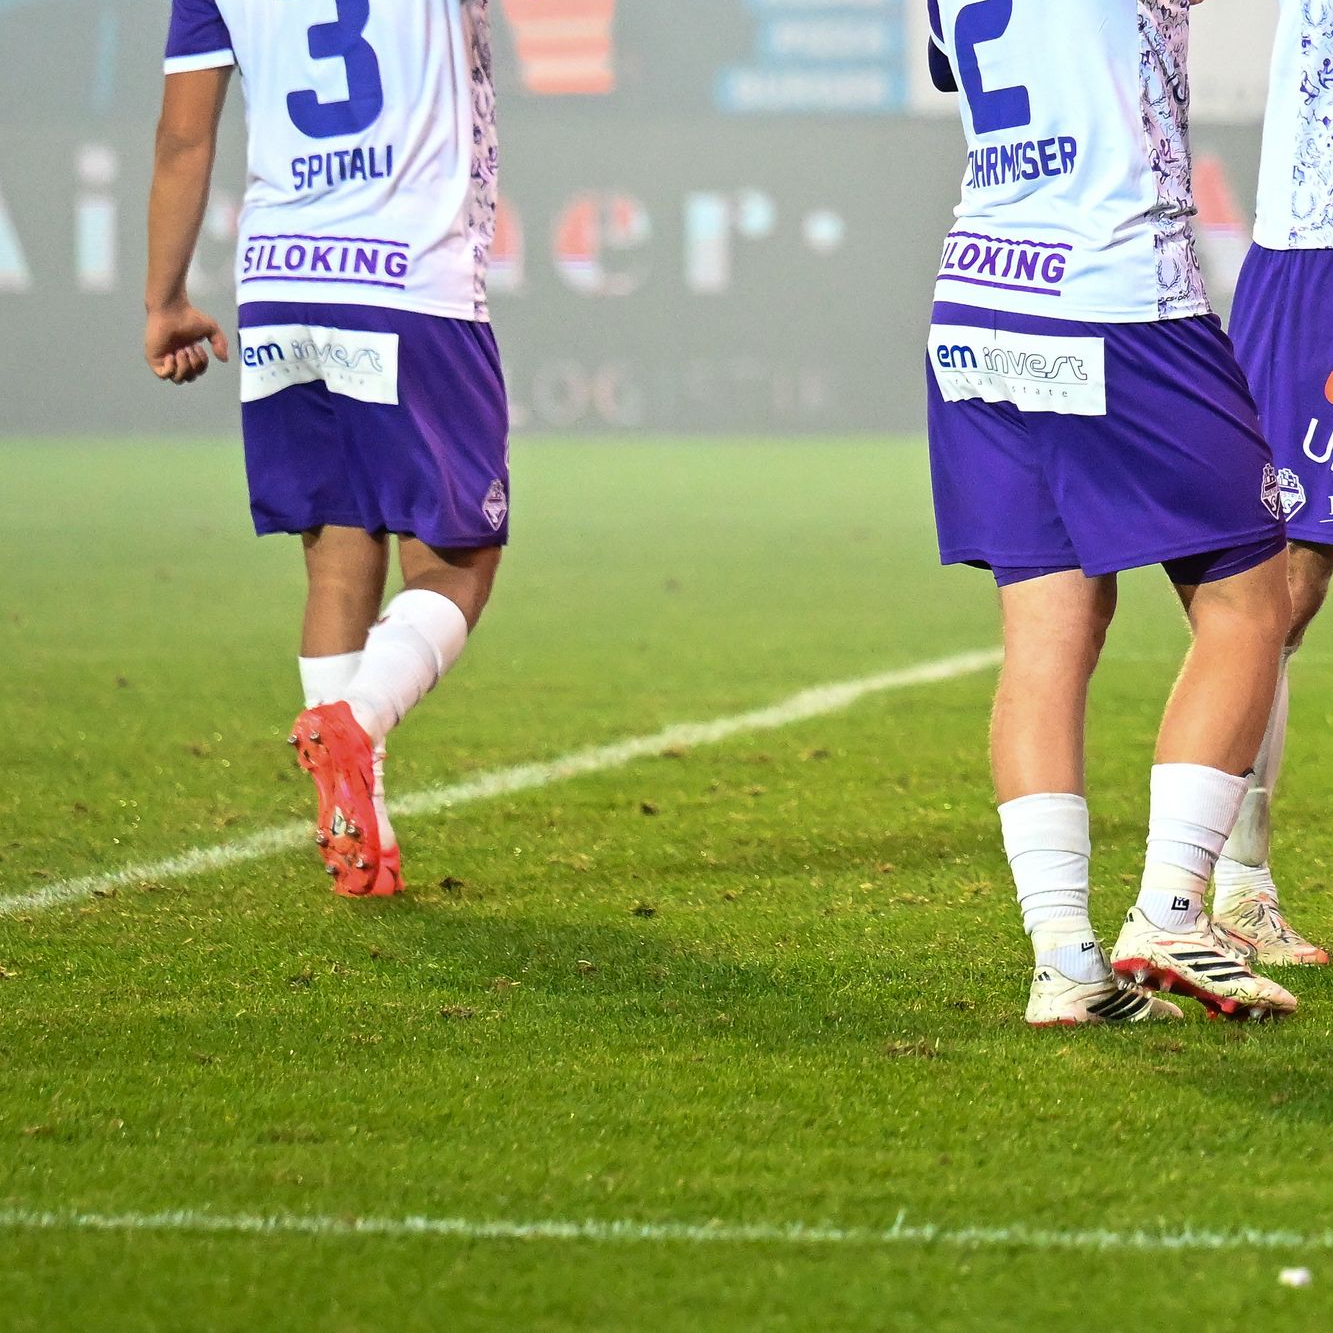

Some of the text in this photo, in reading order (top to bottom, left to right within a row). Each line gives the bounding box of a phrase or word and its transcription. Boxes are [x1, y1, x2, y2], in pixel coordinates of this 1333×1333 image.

[291, 145, 393, 191] SPITALI
[243, 244, 409, 278] SILOKING
[242, 339, 383, 373] em invest
[936, 344, 1088, 381] em invest
[1011, 385, 1068, 398] state
